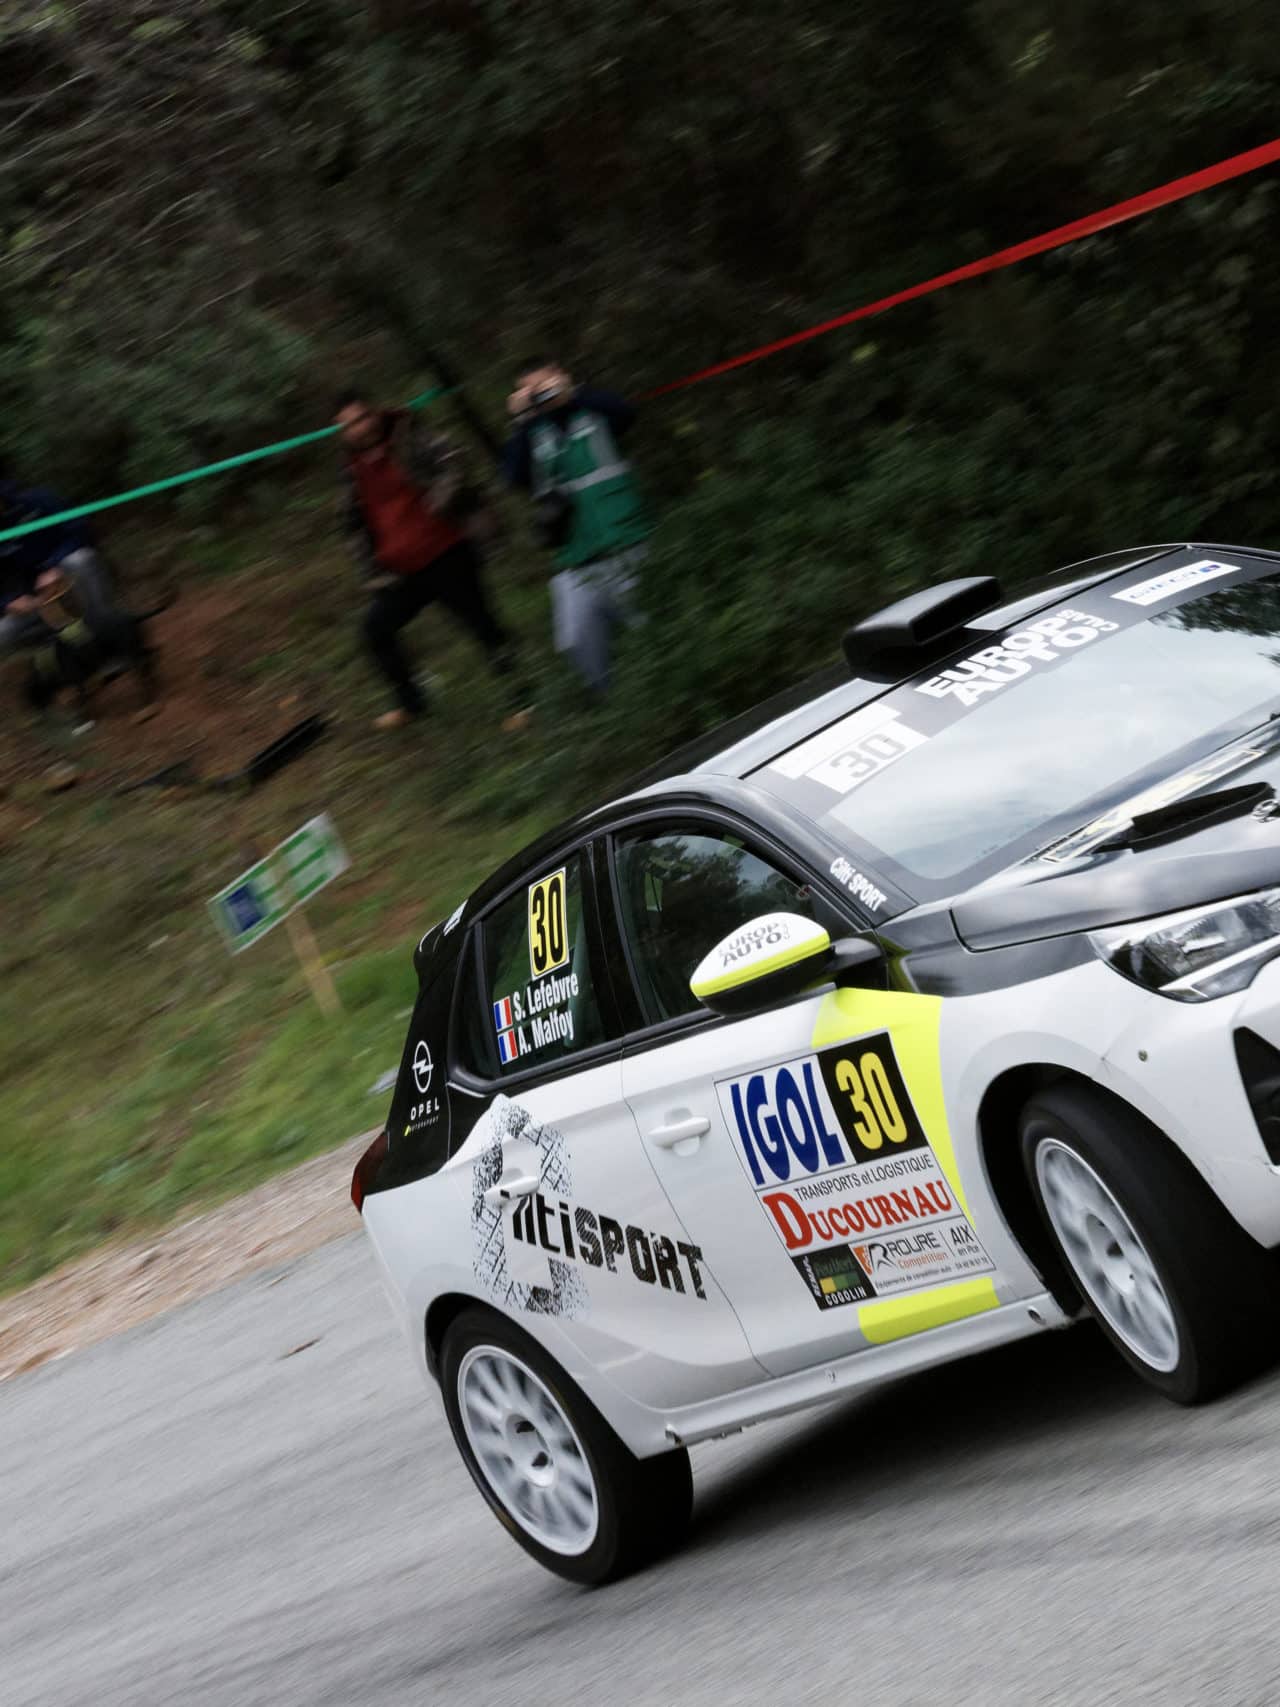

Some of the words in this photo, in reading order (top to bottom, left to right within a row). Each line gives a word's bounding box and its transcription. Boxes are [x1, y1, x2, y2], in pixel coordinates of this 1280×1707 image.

[914, 616, 1067, 698] EUROP
[953, 626, 1099, 706] AUTO
[830, 734, 906, 778] 30
[848, 873, 888, 912] SPORT
[532, 876, 564, 971] 30
[723, 932, 783, 968] AUTO
[513, 991, 527, 1022] S.
[527, 972, 580, 1015] Lefebvre
[518, 1026, 532, 1056] A.
[532, 1009, 574, 1048] Malfoy
[411, 1097, 440, 1121] OPEL
[730, 1062, 846, 1186] IGOL
[835, 1052, 908, 1149] 30
[796, 1173, 860, 1202] TRANSPORTS
[861, 1173, 872, 1185] et
[871, 1154, 934, 1182] LOGISTIQUE
[763, 1180, 952, 1250] DUCOURNAU
[950, 1225, 975, 1245] AIX
[886, 1232, 941, 1258] ROURE
